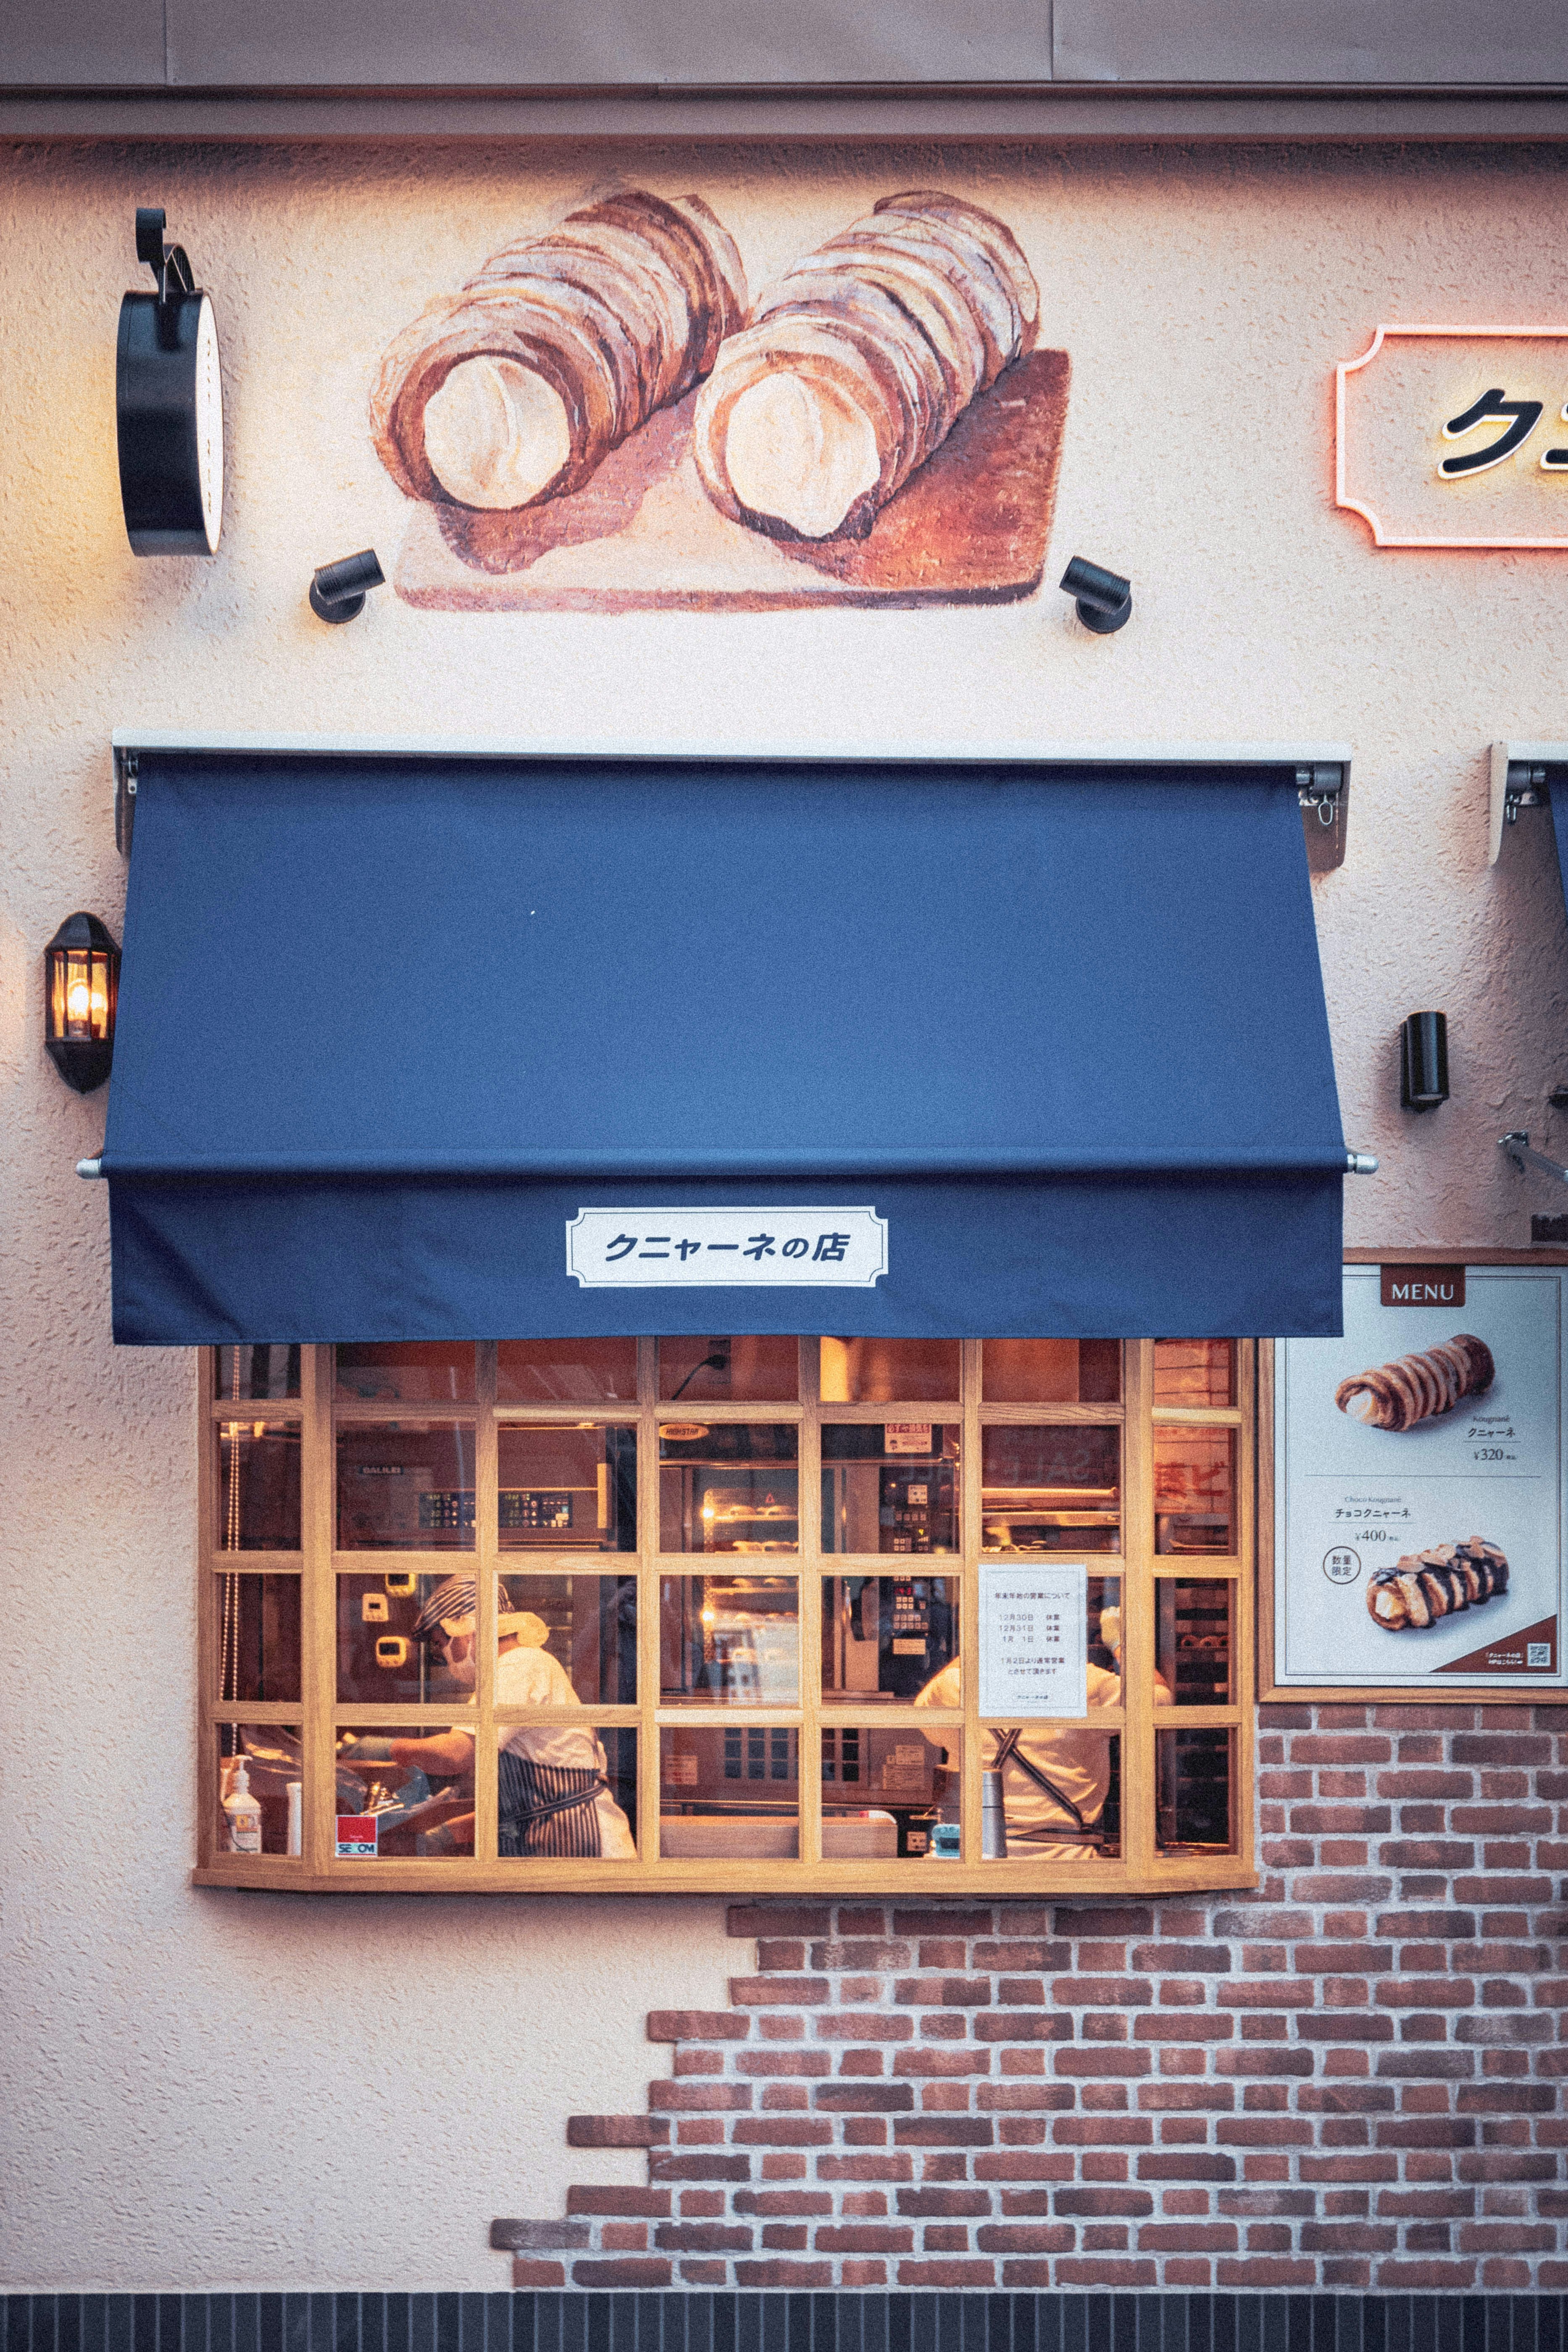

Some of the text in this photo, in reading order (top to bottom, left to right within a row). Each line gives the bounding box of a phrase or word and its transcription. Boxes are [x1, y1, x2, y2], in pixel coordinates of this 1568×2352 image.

[605, 1232, 851, 1261] クニャーネの店
[1392, 1284, 1454, 1300] MENU
[1468, 1427, 1515, 1438] クニャーネ
[1474, 1448, 1503, 1460] ¥320
[1335, 1508, 1411, 1518] チョコクニャーネ
[1355, 1530, 1386, 1541] ¥400
[1331, 1555, 1351, 1565] 数量
[1331, 1567, 1352, 1576] 限定
